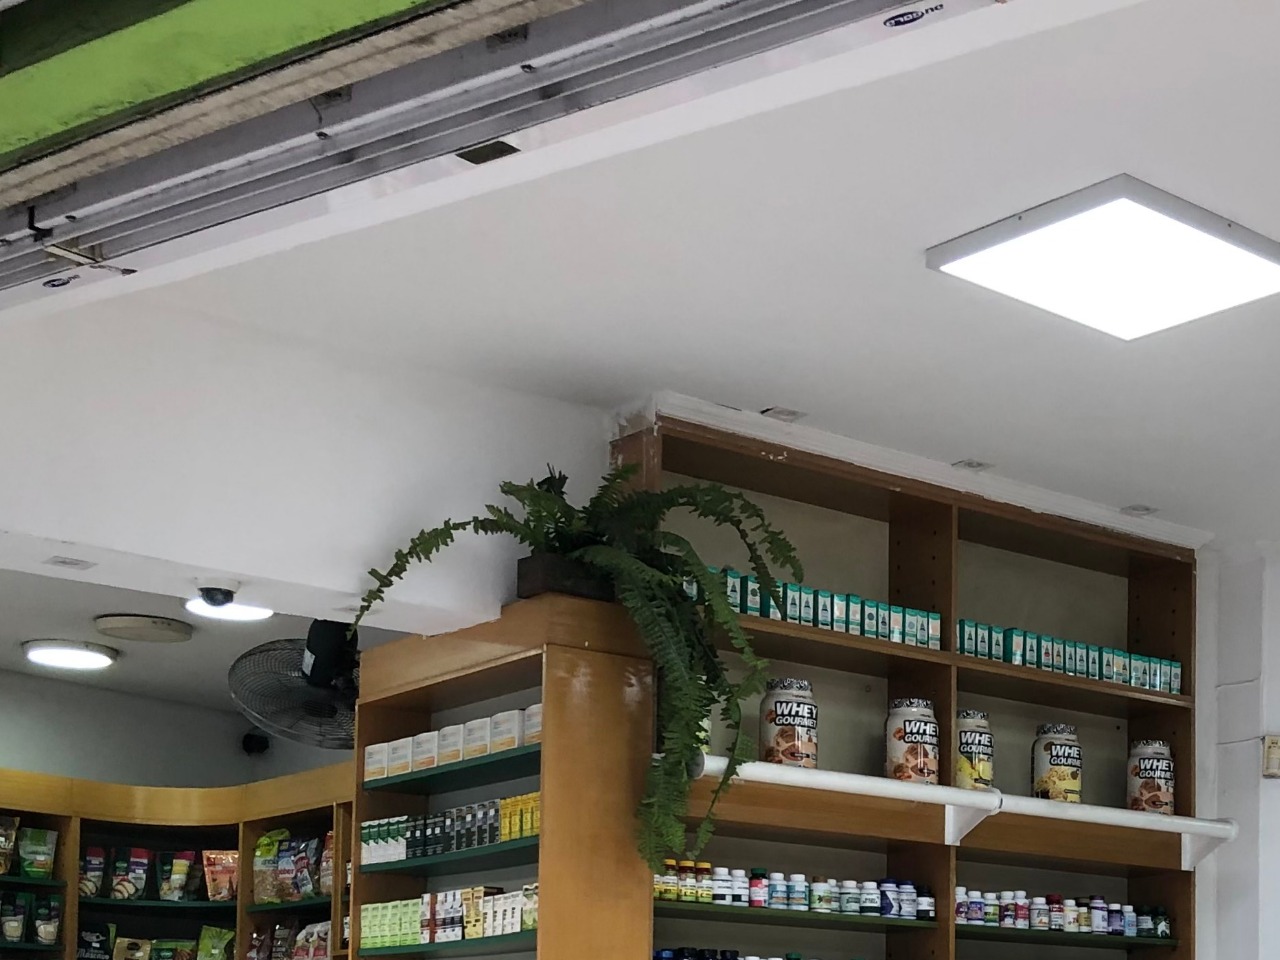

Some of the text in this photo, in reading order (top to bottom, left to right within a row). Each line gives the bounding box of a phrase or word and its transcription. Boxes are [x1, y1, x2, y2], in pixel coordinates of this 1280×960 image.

[776, 701, 818, 719] WHEY
[775, 715, 818, 728] GOURMET
[905, 720, 939, 736] WHE
[904, 733, 939, 746] GOURME
[960, 731, 994, 747] WHE
[960, 743, 994, 755] GOURME
[1051, 744, 1082, 758] WHE
[1050, 756, 1082, 767] GOURME
[1139, 758, 1175, 772] WHEY
